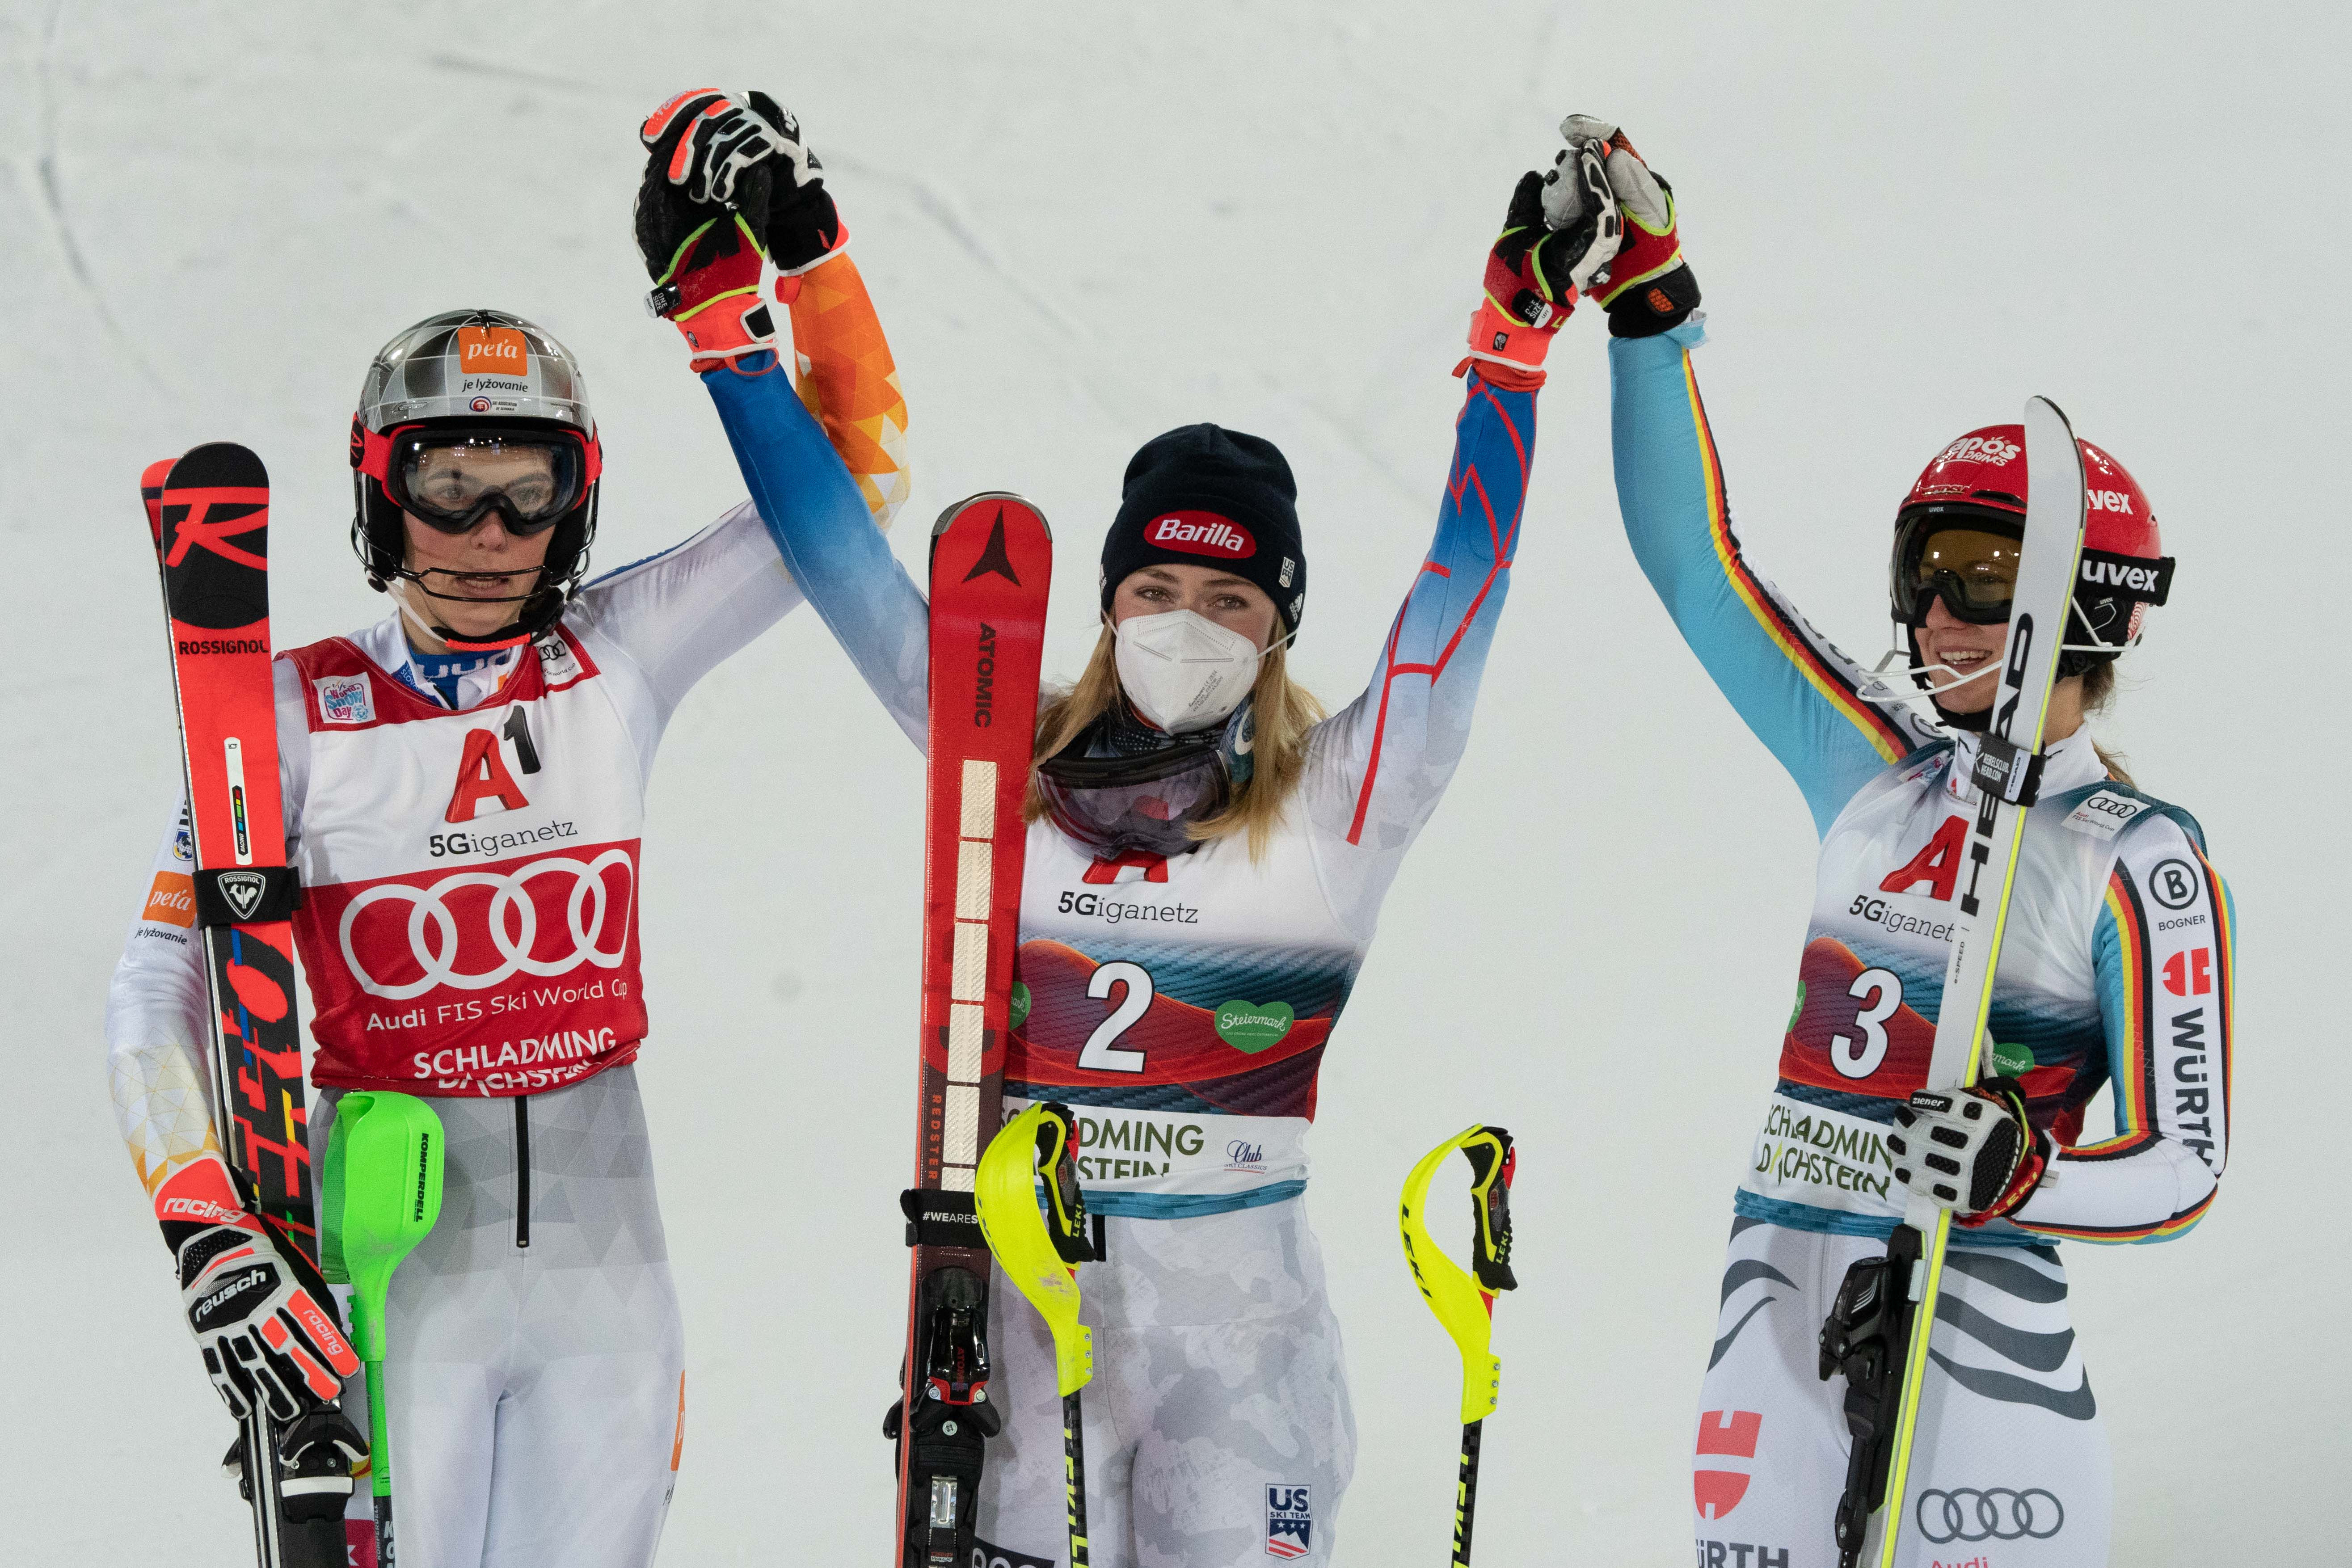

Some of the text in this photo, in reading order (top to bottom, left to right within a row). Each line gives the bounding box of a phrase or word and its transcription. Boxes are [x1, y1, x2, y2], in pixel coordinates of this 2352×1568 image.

[653, 295, 662, 311] SIZE
[658, 292, 668, 308] ONE
[1525, 299, 1538, 315] OE
[1530, 303, 1543, 319] SIZE
[1542, 309, 1550, 319] LEFT
[462, 378, 528, 392] je lyžovanie
[1966, 451, 2008, 467] DRINKS
[2087, 489, 2133, 514] vex
[1155, 519, 1244, 552] Barilla
[1283, 558, 1294, 572] US
[2082, 559, 2159, 592] uvex
[179, 640, 269, 655] ROSSIGNOL
[974, 622, 996, 728] ATOMIC
[333, 706, 352, 718] Day
[1980, 764, 2003, 783] HEAD.COM
[2089, 820, 2104, 828] World
[238, 833, 246, 853] RACING
[429, 819, 578, 859] 5Giganetz
[224, 876, 260, 884] ROSSIGNOL
[1058, 891, 1198, 923] 5Giganetz
[1849, 894, 1953, 942] 5Giganet
[2158, 914, 2207, 932] BOGNER
[135, 927, 188, 945] je lyžovanie
[366, 1011, 426, 1032] Audi
[437, 1002, 483, 1024] FIS
[490, 995, 528, 1015] Ski
[532, 980, 605, 1007] World
[1077, 960, 1155, 1073] 2
[1221, 1013, 1286, 1032] Steiermark
[1829, 966, 1903, 1079] 3
[414, 1027, 616, 1079] SCHLADMING
[2170, 1007, 2216, 1168] WÜRTH
[1912, 1096, 1945, 1108] ziener
[928, 1095, 942, 1180] REDSTER
[1079, 1117, 1204, 1159] DMING
[1764, 1104, 1893, 1172] SCHLADMIN
[1227, 1140, 1262, 1163] Club
[416, 1132, 429, 1222] KOMPERDELL
[1078, 1155, 1170, 1180] STEIN
[1755, 1140, 1891, 1201] DACHSTEIN
[163, 1197, 248, 1224] racing
[922, 1211, 978, 1224] #WEARES
[1072, 1204, 1082, 1238] LEKI
[1399, 1203, 1434, 1299] LEKI
[1496, 1231, 1510, 1265] LEKI
[195, 1269, 266, 1323] reusch
[303, 1309, 344, 1356] racing
[1269, 1488, 1308, 1512] US
